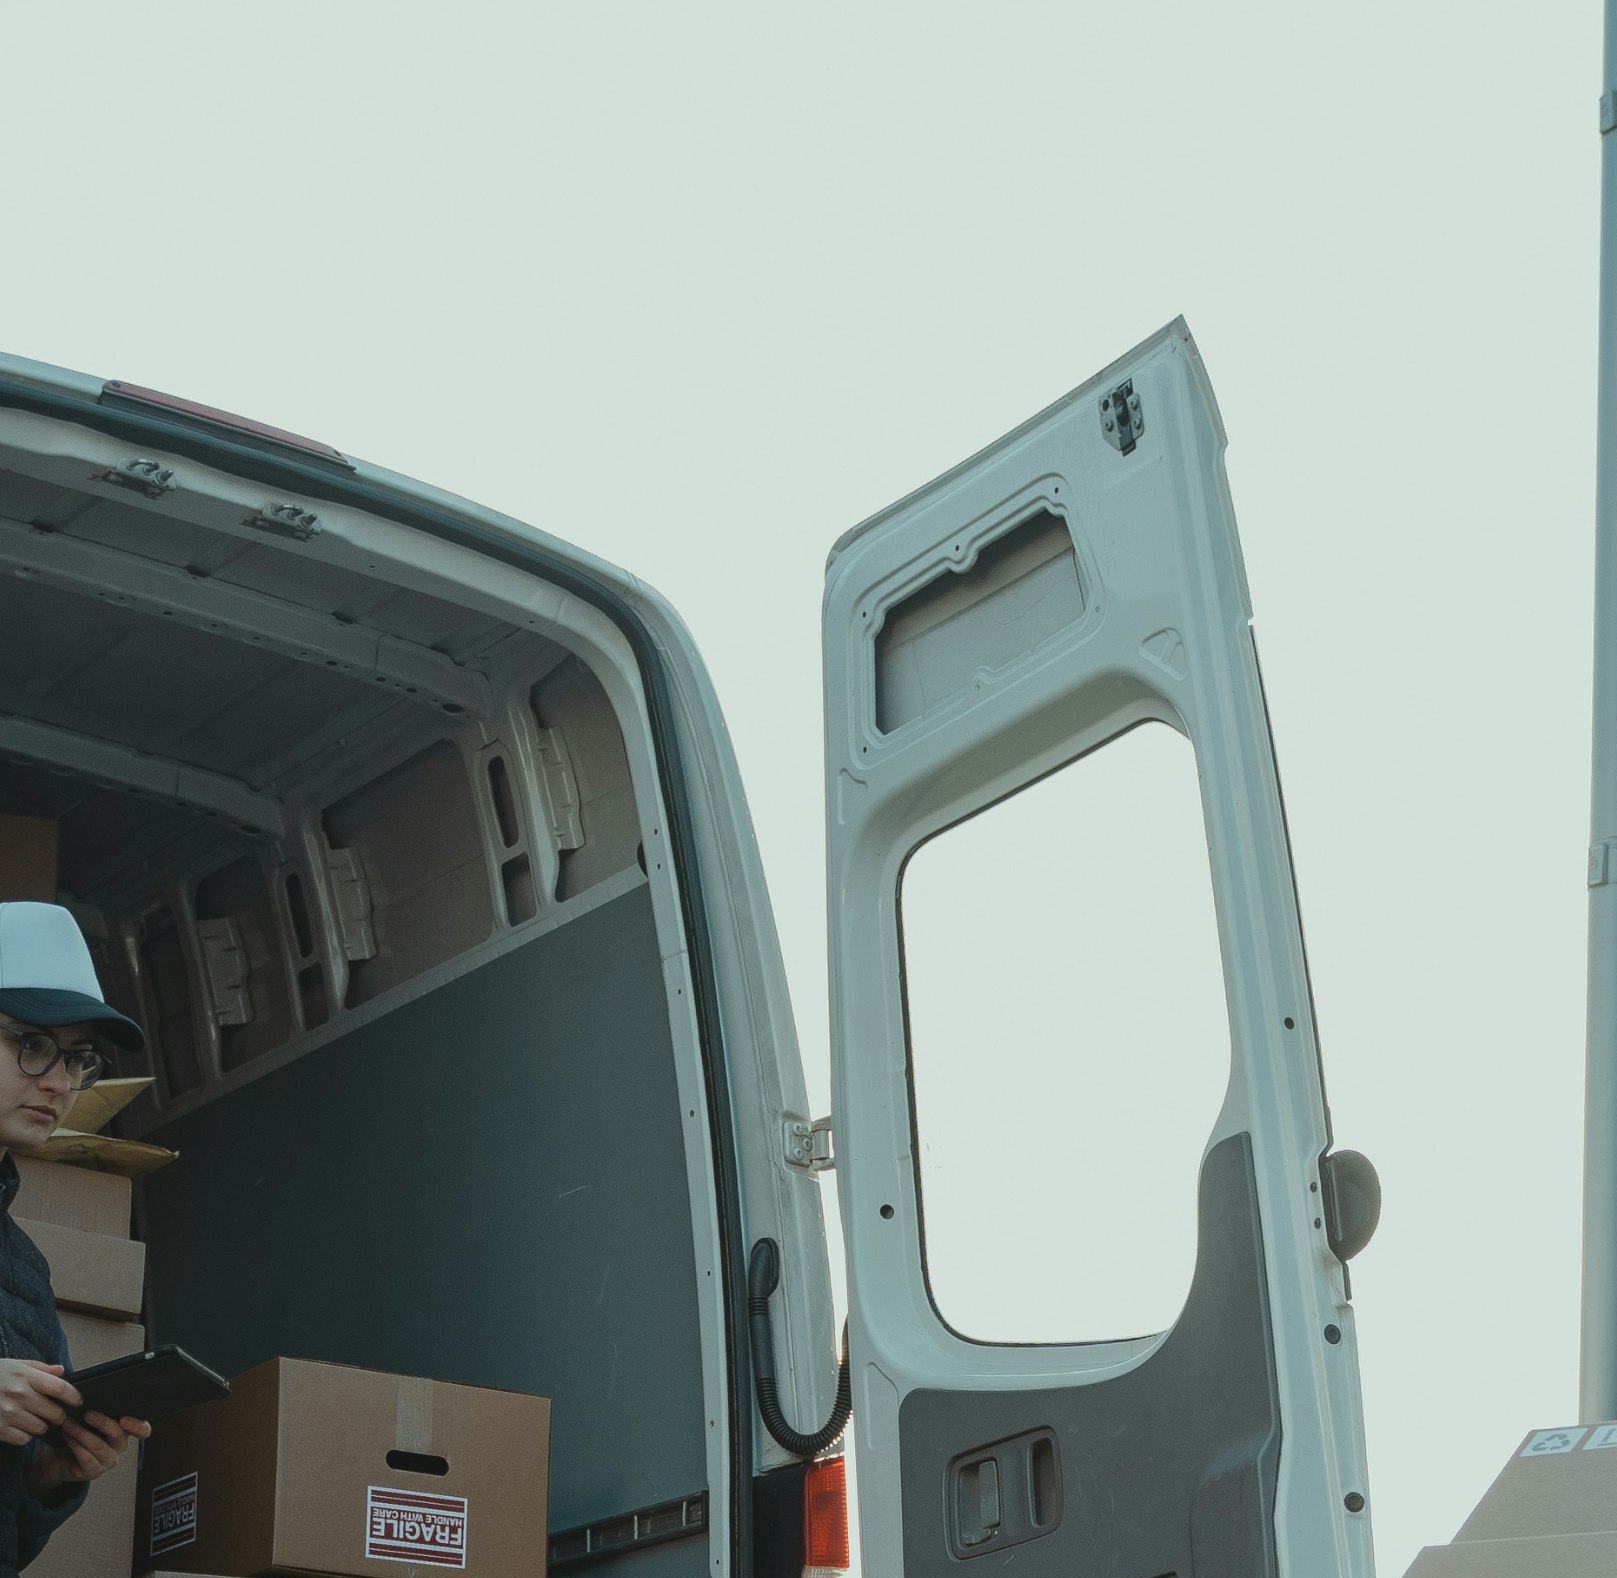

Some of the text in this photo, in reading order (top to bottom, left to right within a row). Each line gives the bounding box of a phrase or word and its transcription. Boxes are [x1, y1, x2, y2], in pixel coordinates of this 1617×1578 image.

[153, 1503, 195, 1533] FRAGILE
[372, 1508, 462, 1526] HANDLE WITH CARE
[372, 1518, 462, 1545] FRAGILE
